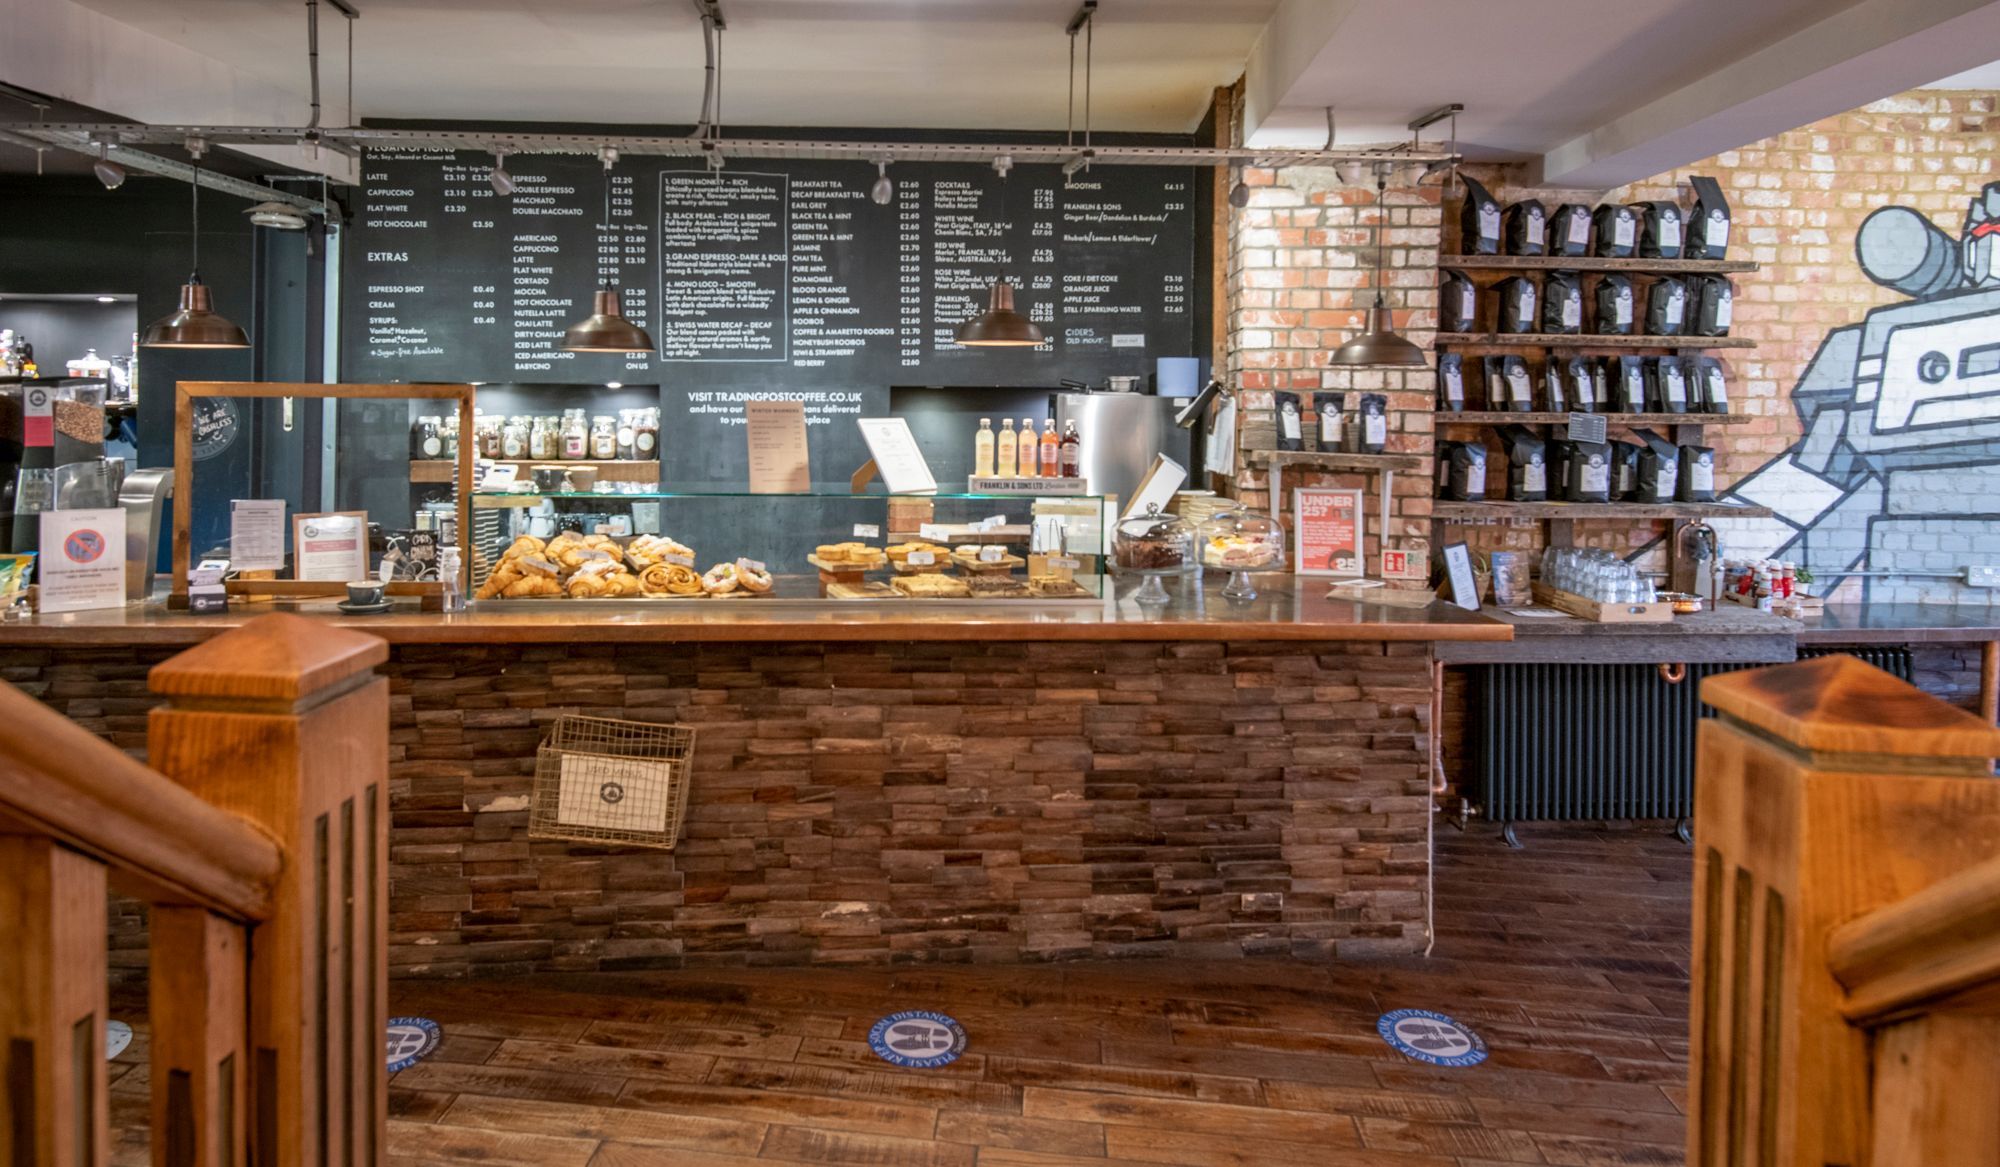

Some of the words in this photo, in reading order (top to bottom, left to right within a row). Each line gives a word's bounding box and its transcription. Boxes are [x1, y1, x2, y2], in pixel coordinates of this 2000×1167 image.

[368, 252, 408, 261] EXTRAS
[688, 392, 713, 401] VISIT
[716, 392, 861, 403] TRADINGPOSTCOFFEE.CO.UK
[690, 405, 706, 413] and
[707, 404, 728, 413] have
[822, 404, 860, 413] delivered
[1302, 496, 1353, 506] UNDER
[1303, 506, 1328, 517] 25?
